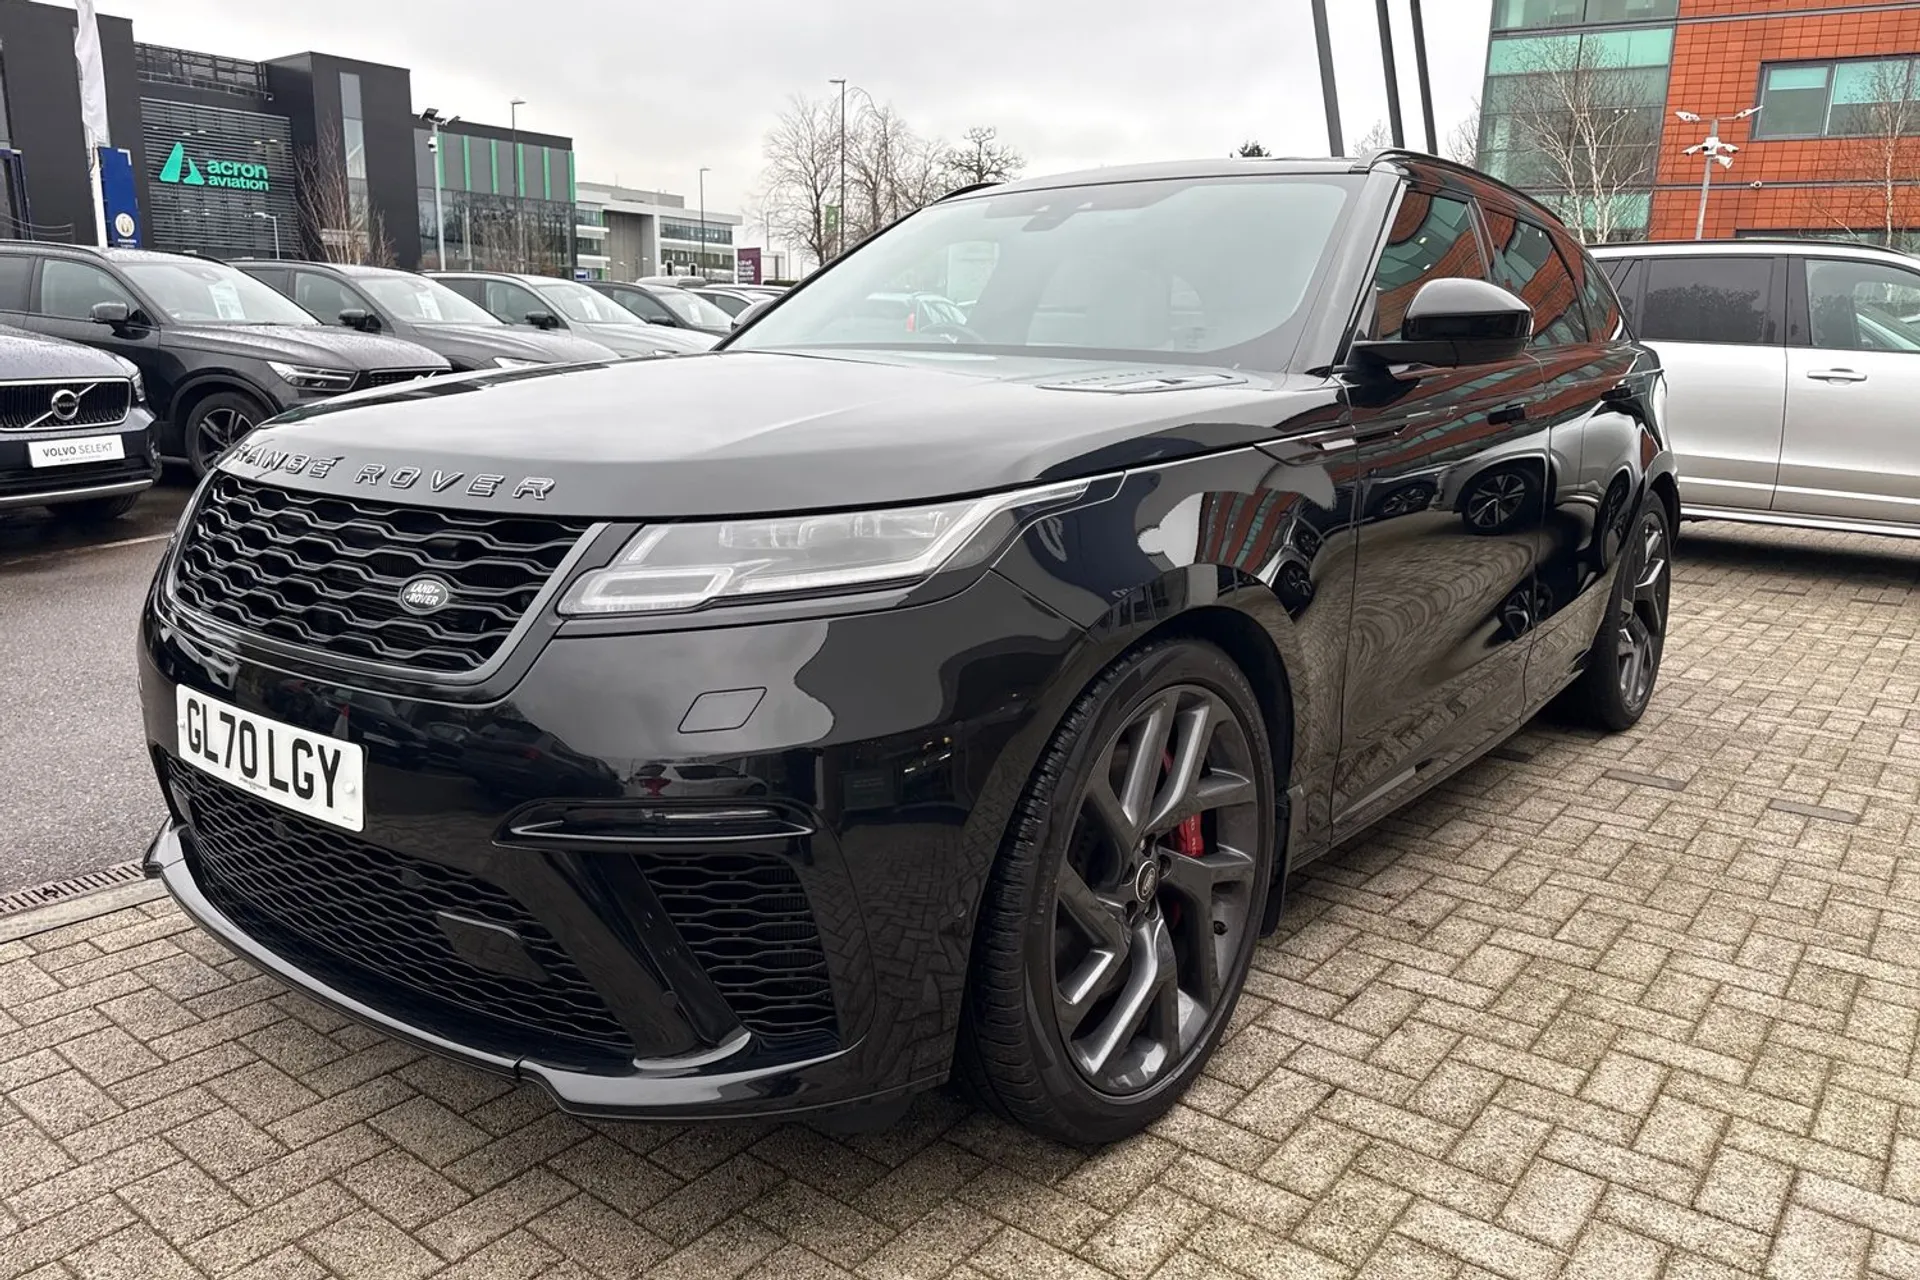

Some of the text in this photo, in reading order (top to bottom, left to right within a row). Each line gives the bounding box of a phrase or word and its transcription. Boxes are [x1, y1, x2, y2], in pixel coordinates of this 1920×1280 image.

[207, 160, 269, 179] acron
[208, 175, 269, 191] aviation
[42, 445, 77, 458] VOLVO
[78, 442, 113, 455] SELEKT
[233, 442, 556, 500] RANGE ROVER
[186, 698, 341, 809] GL70 LGY
